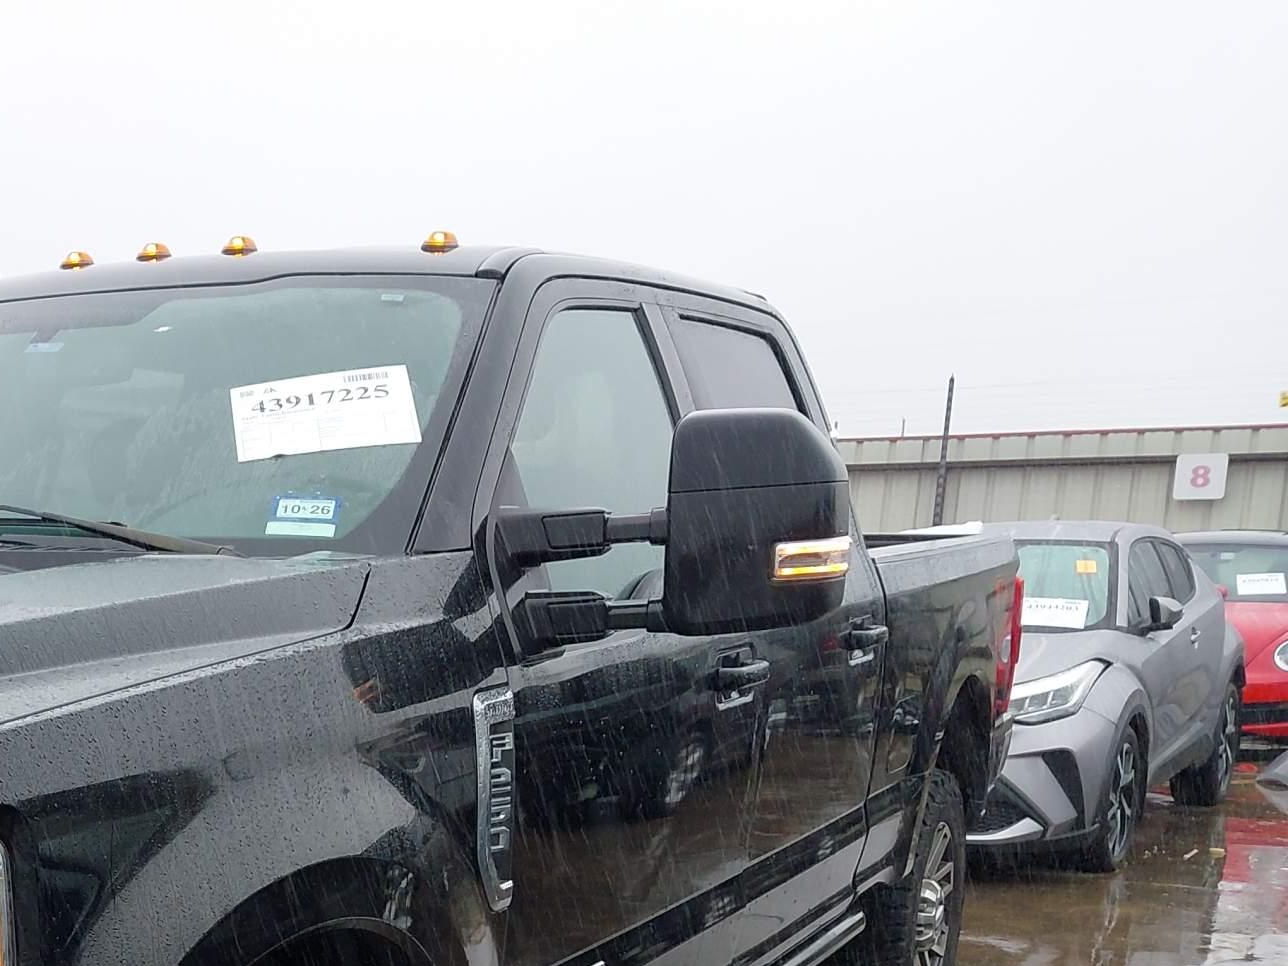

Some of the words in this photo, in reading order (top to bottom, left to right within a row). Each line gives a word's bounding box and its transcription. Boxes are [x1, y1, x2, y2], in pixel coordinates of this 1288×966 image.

[251, 384, 390, 413] 43917225
[1190, 465, 1211, 488] 8
[309, 504, 331, 515] 26
